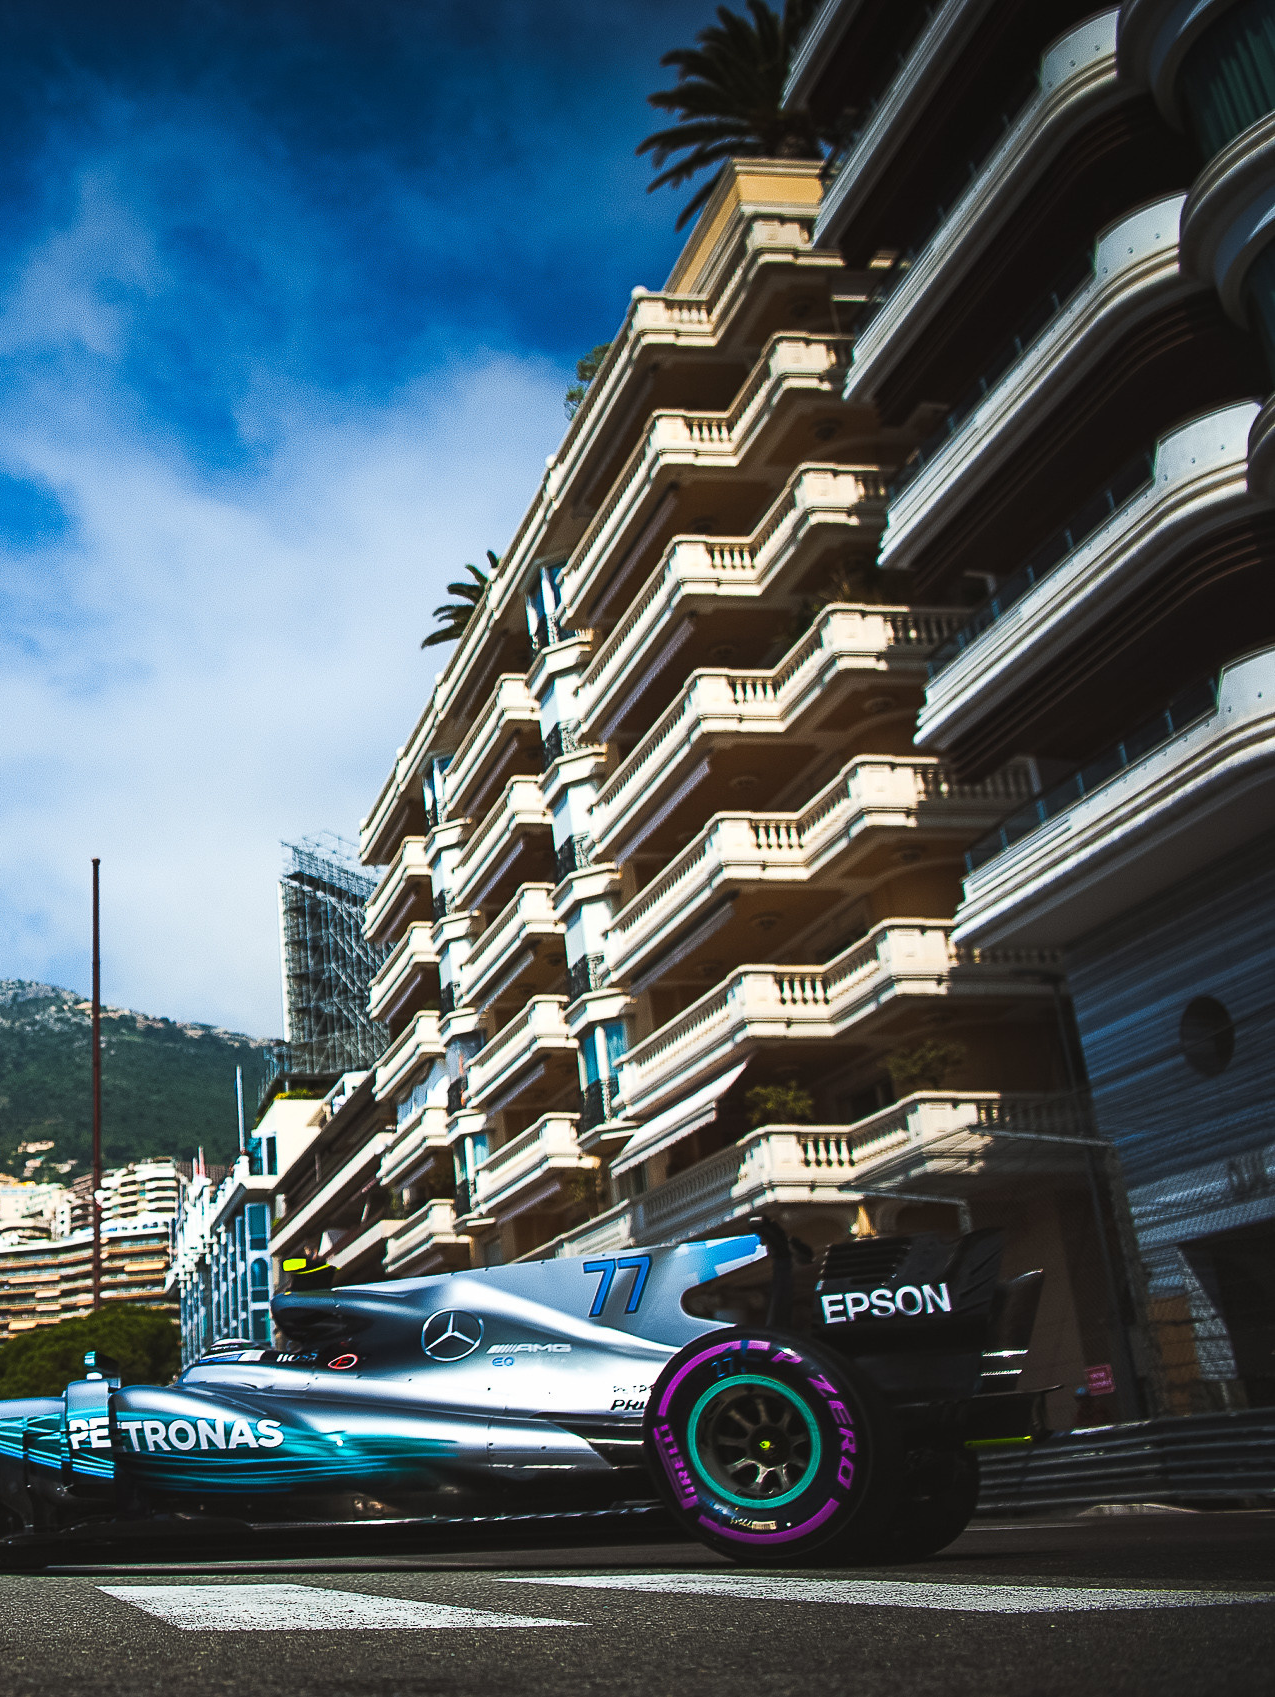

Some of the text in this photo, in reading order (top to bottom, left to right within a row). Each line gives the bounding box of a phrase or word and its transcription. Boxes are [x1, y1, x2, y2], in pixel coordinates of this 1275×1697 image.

[582, 1254, 654, 1319] 77
[821, 1283, 953, 1325] EPSON
[491, 1356, 516, 1367] EQ
[68, 1417, 285, 1452] PETRONAS
[771, 1347, 857, 1490] P ZERO
[653, 1422, 699, 1510] PIRELLI
